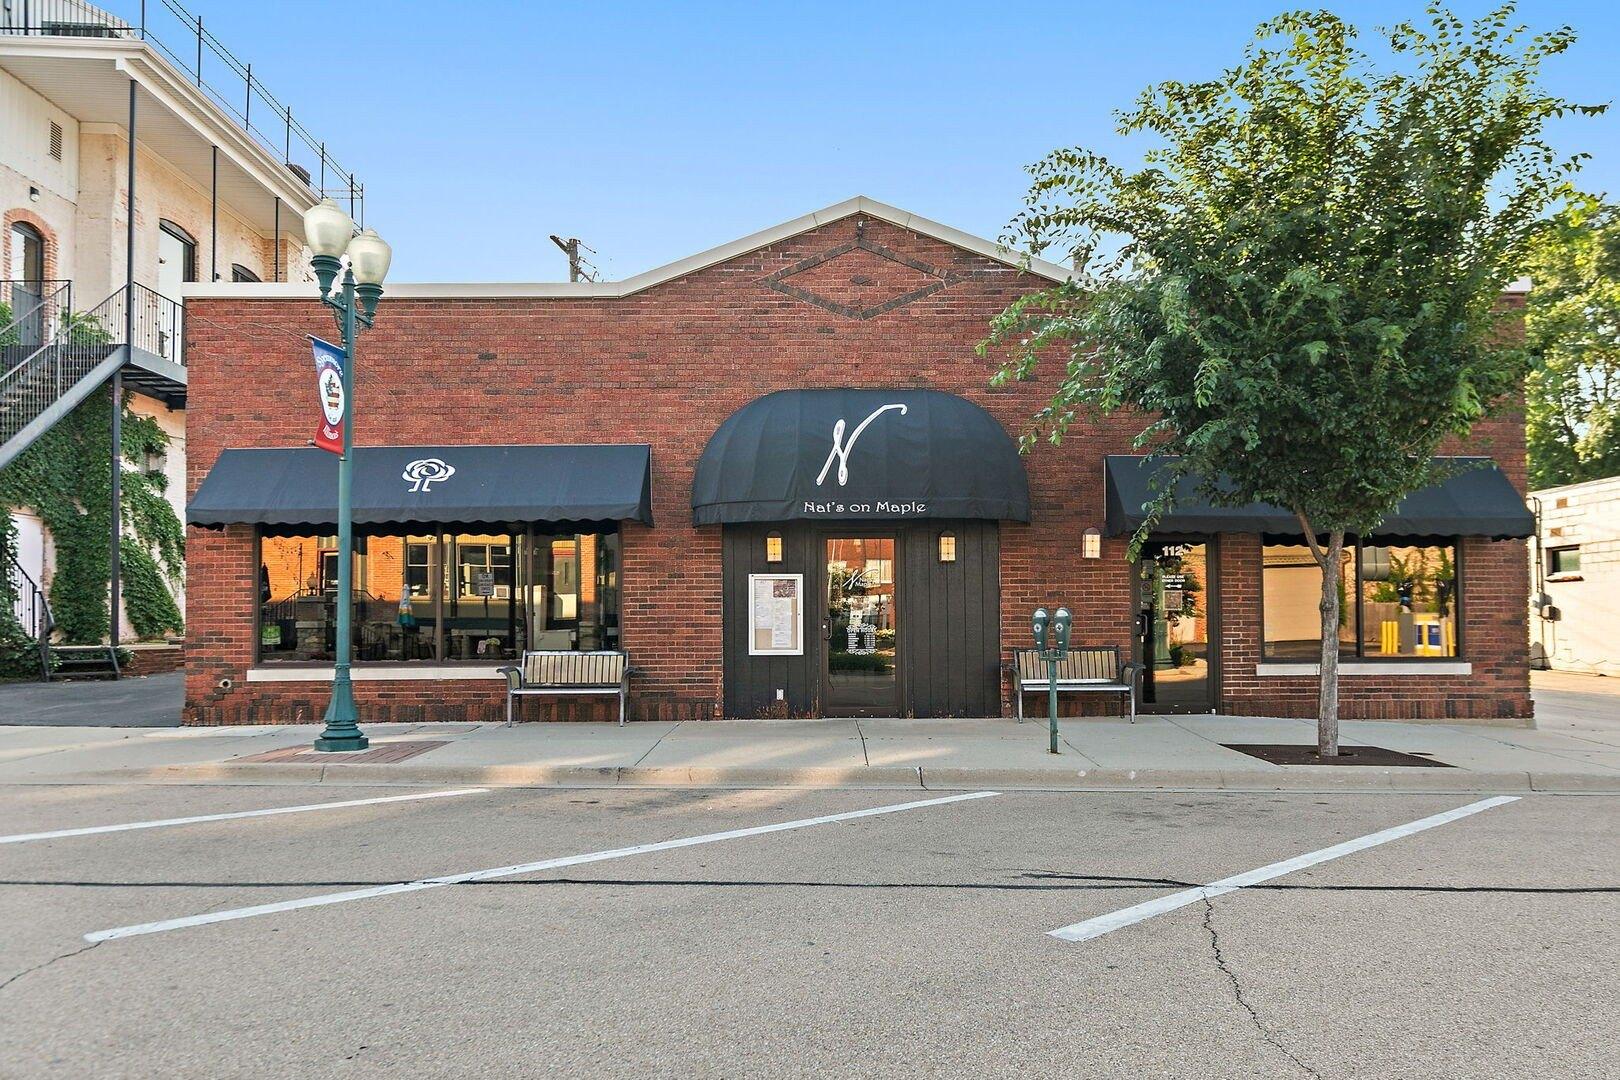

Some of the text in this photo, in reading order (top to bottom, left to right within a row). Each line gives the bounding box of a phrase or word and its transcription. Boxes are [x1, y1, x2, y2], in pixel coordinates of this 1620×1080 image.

[804, 501, 926, 514] Nat's on Maple
[1162, 545, 1183, 556] 112
